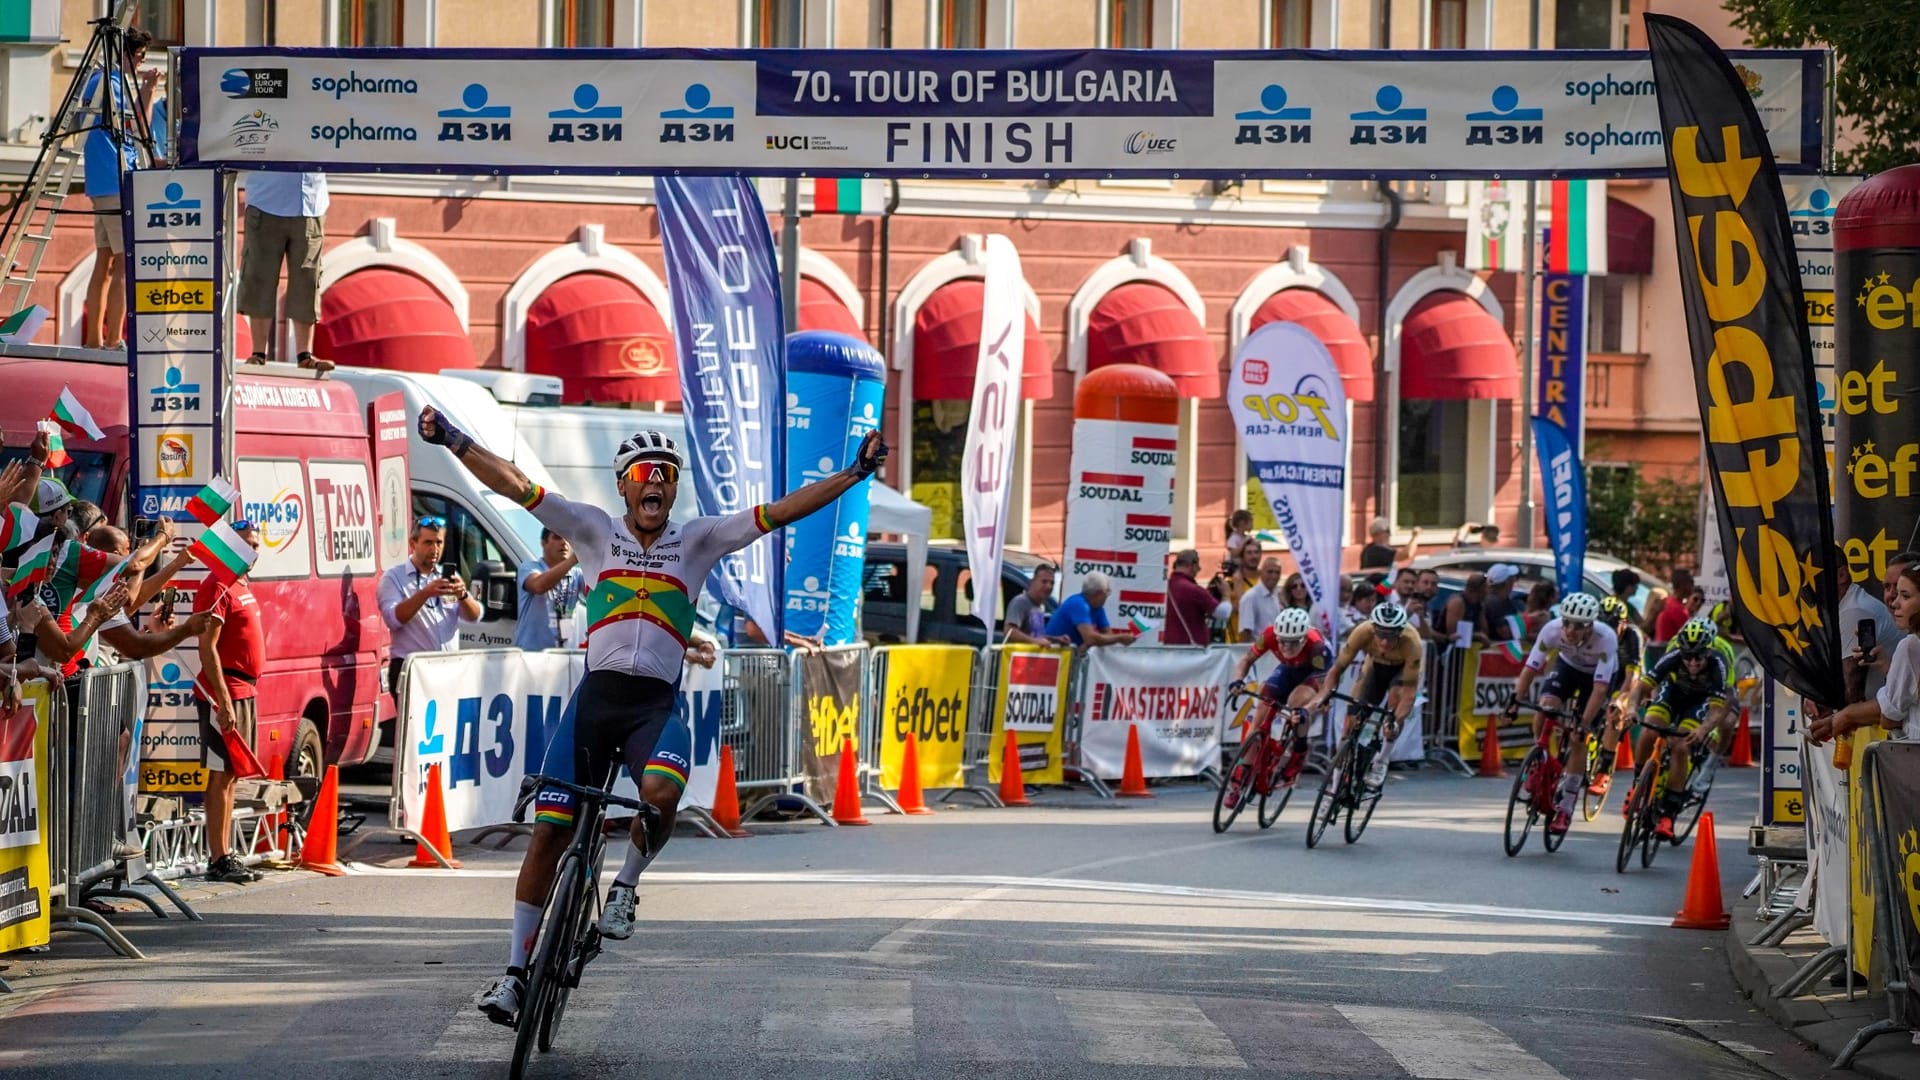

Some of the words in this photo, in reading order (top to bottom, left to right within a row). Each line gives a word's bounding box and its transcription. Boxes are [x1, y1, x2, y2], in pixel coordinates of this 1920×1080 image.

[311, 70, 418, 99] sopharma
[791, 71, 840, 103] 70.
[850, 71, 938, 103] TOUR
[951, 71, 996, 103] OF
[1007, 69, 1177, 103] BULGARIA
[311, 118, 417, 149] sopharma
[438, 122, 511, 142] ДЗИ
[548, 122, 622, 143] ДЗИ
[660, 122, 734, 143] ДЗИ
[1235, 124, 1311, 145] ДЗИ
[1350, 124, 1427, 145] ДЗИ
[1466, 124, 1543, 145] ДЗИ
[774, 135, 808, 150] UCI
[886, 122, 1073, 163] FINISH
[1147, 139, 1177, 150] UEC
[147, 212, 201, 228] ДЗИ
[1793, 220, 1830, 236] ДЗ
[141, 251, 208, 271] sopharma
[149, 289, 204, 306] efbet
[1806, 300, 1834, 317] fbe
[166, 328, 207, 336] Metarex
[151, 397, 200, 412] ДЗИ
[787, 416, 810, 429] ЗИ
[160, 496, 192, 511] MAP
[1080, 486, 1143, 503] SOUDAL
[245, 503, 282, 523] СТАРС
[285, 503, 299, 523] 94
[786, 597, 830, 613] ДЗИ
[1006, 692, 1055, 724] SOUDAL
[1112, 686, 1219, 721] MASTERHAUS
[895, 688, 963, 743] efbet
[144, 769, 202, 785] efbet
